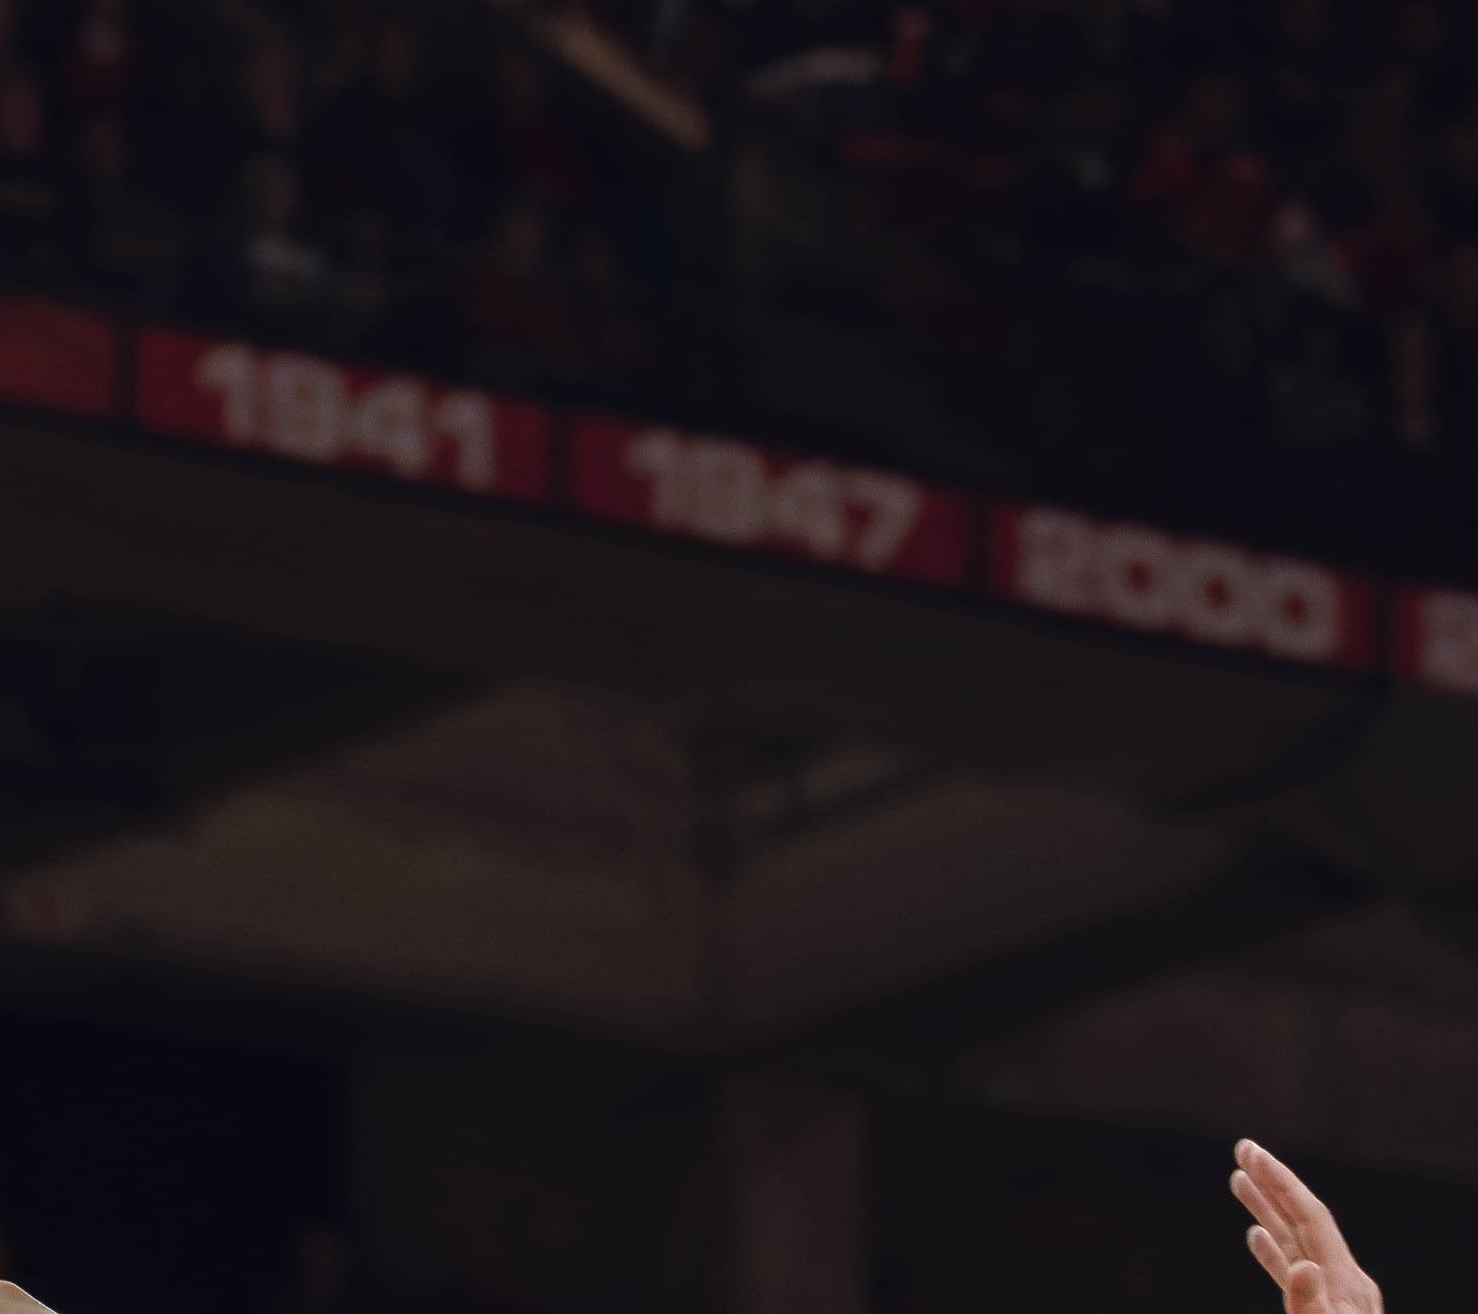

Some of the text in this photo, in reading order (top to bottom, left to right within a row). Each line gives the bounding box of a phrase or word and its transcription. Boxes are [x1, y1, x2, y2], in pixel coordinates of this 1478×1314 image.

[194, 343, 498, 490] 1941
[626, 427, 922, 574] 1947
[1017, 508, 1342, 662] 2000
